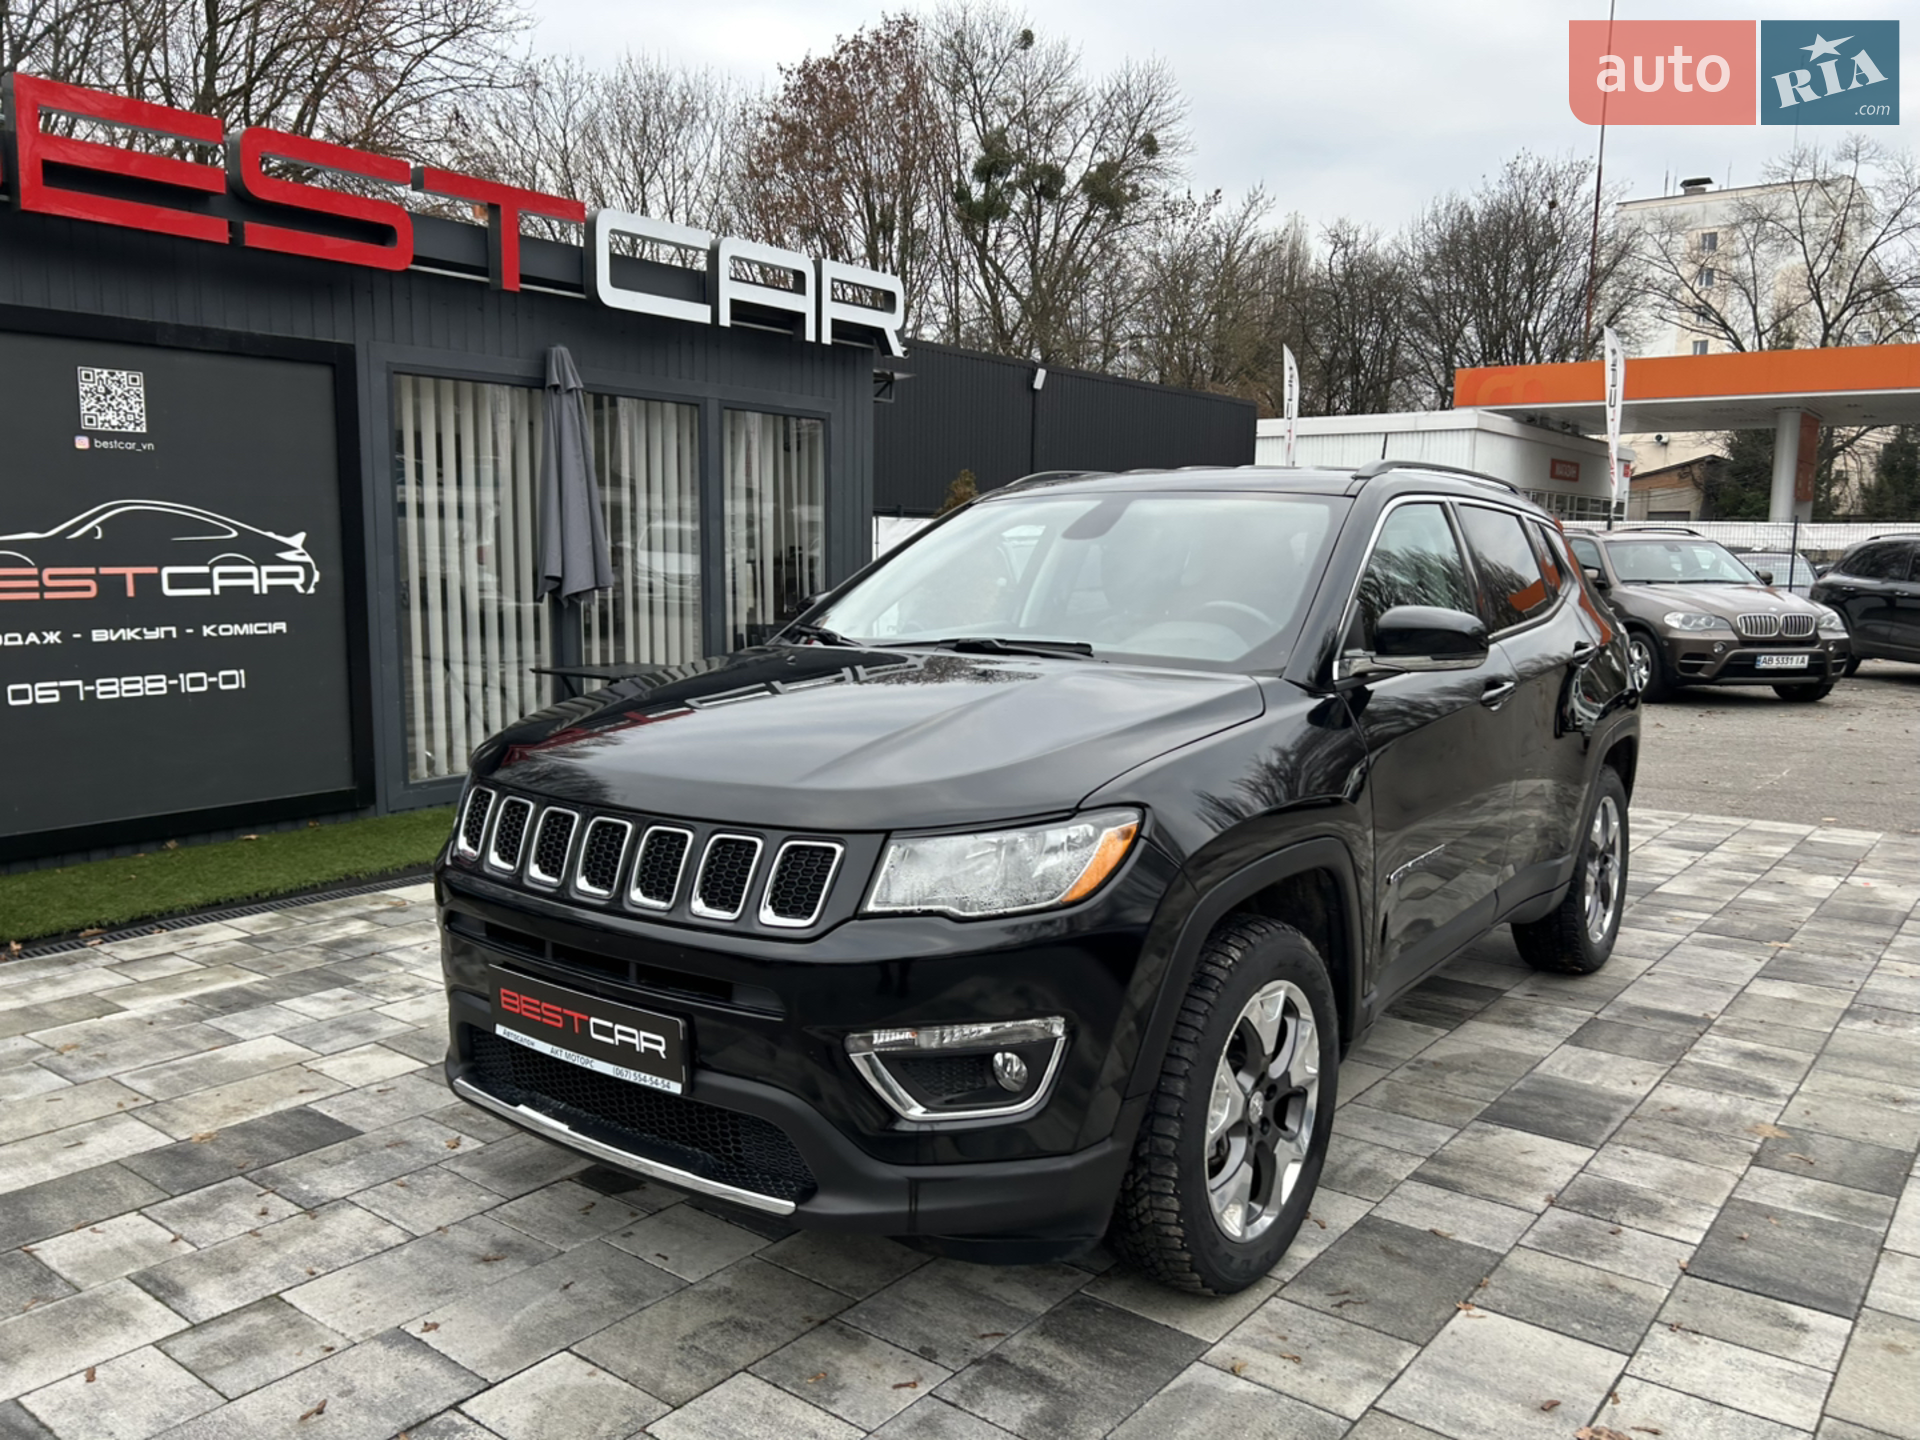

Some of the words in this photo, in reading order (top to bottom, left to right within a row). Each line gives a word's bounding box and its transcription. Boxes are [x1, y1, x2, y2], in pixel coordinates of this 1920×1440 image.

[0, 72, 907, 357] ESTCAR
[93, 437, 155, 452] bestcar_vn
[91, 626, 177, 642] ВИКУП
[202, 621, 287, 637] КОМІСІЯ
[6, 668, 246, 706] 067-888-10-01
[500, 988, 667, 1059] BESTCAR
[612, 1066, 632, 1079] (067)
[633, 1071, 671, 1090] 554-54-54
